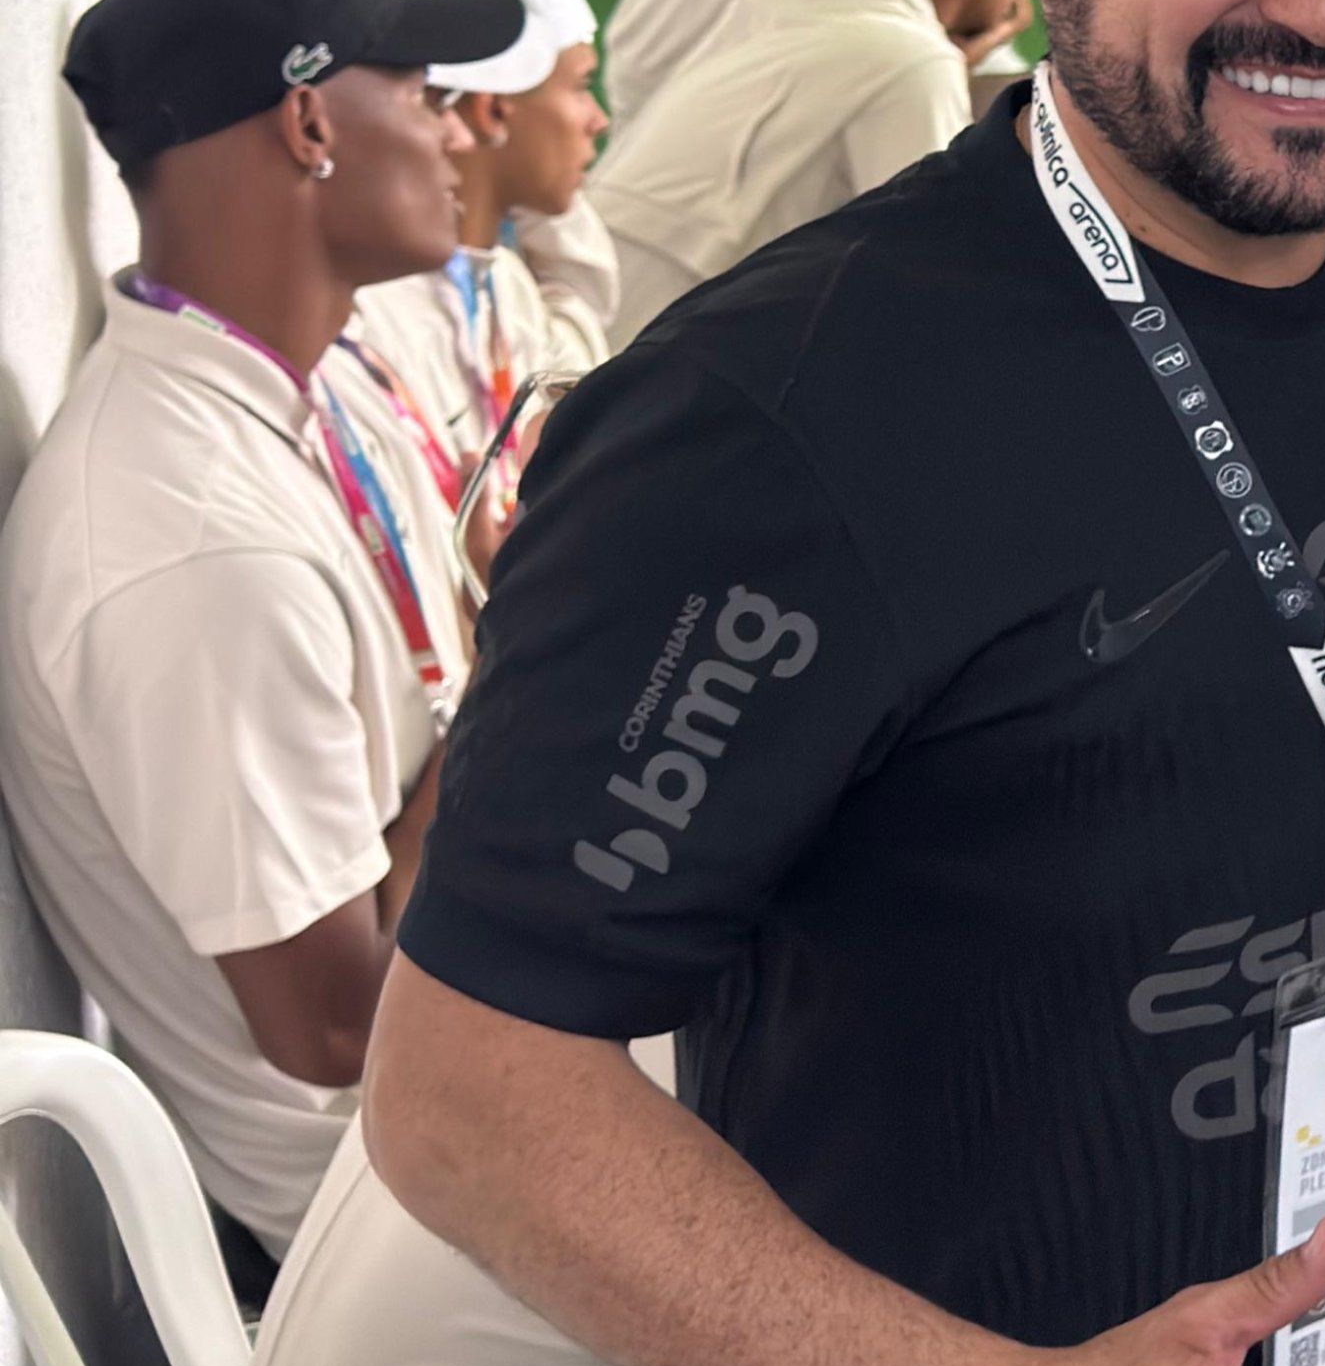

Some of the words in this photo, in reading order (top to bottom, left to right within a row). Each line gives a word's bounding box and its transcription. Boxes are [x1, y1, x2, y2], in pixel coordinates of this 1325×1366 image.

[1069, 201, 1119, 271] arena
[606, 585, 819, 831] bmg
[618, 593, 708, 753] CORINTHIANS
